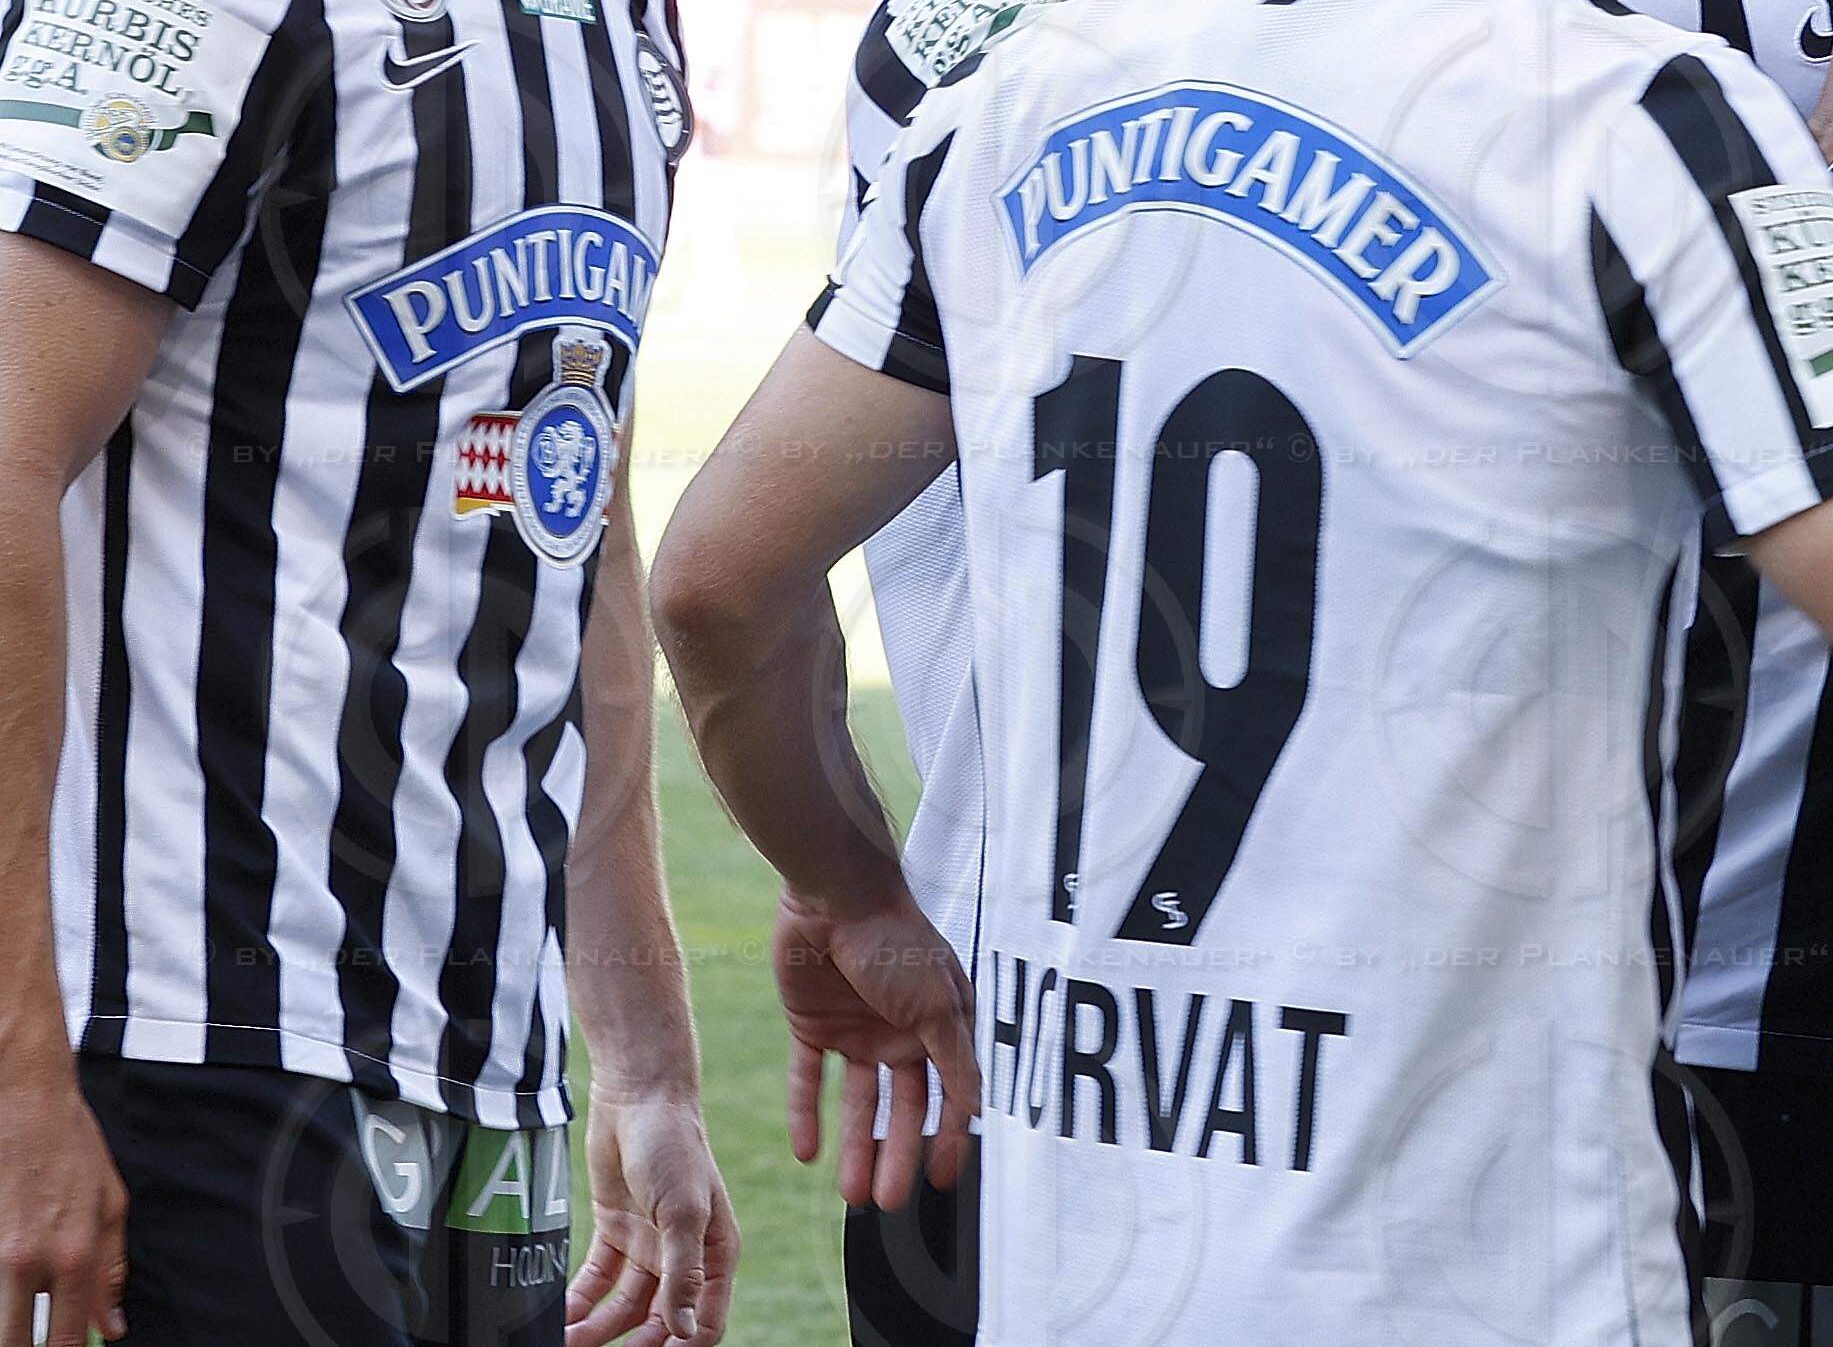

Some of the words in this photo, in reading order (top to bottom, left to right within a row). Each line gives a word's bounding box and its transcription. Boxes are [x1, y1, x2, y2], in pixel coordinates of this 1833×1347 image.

[21, 19, 183, 98] KERNÖL
[1020, 105, 1462, 326] PUNTIGAMER
[1029, 355, 1323, 947] 19
[990, 949, 1348, 1172] HORVAT
